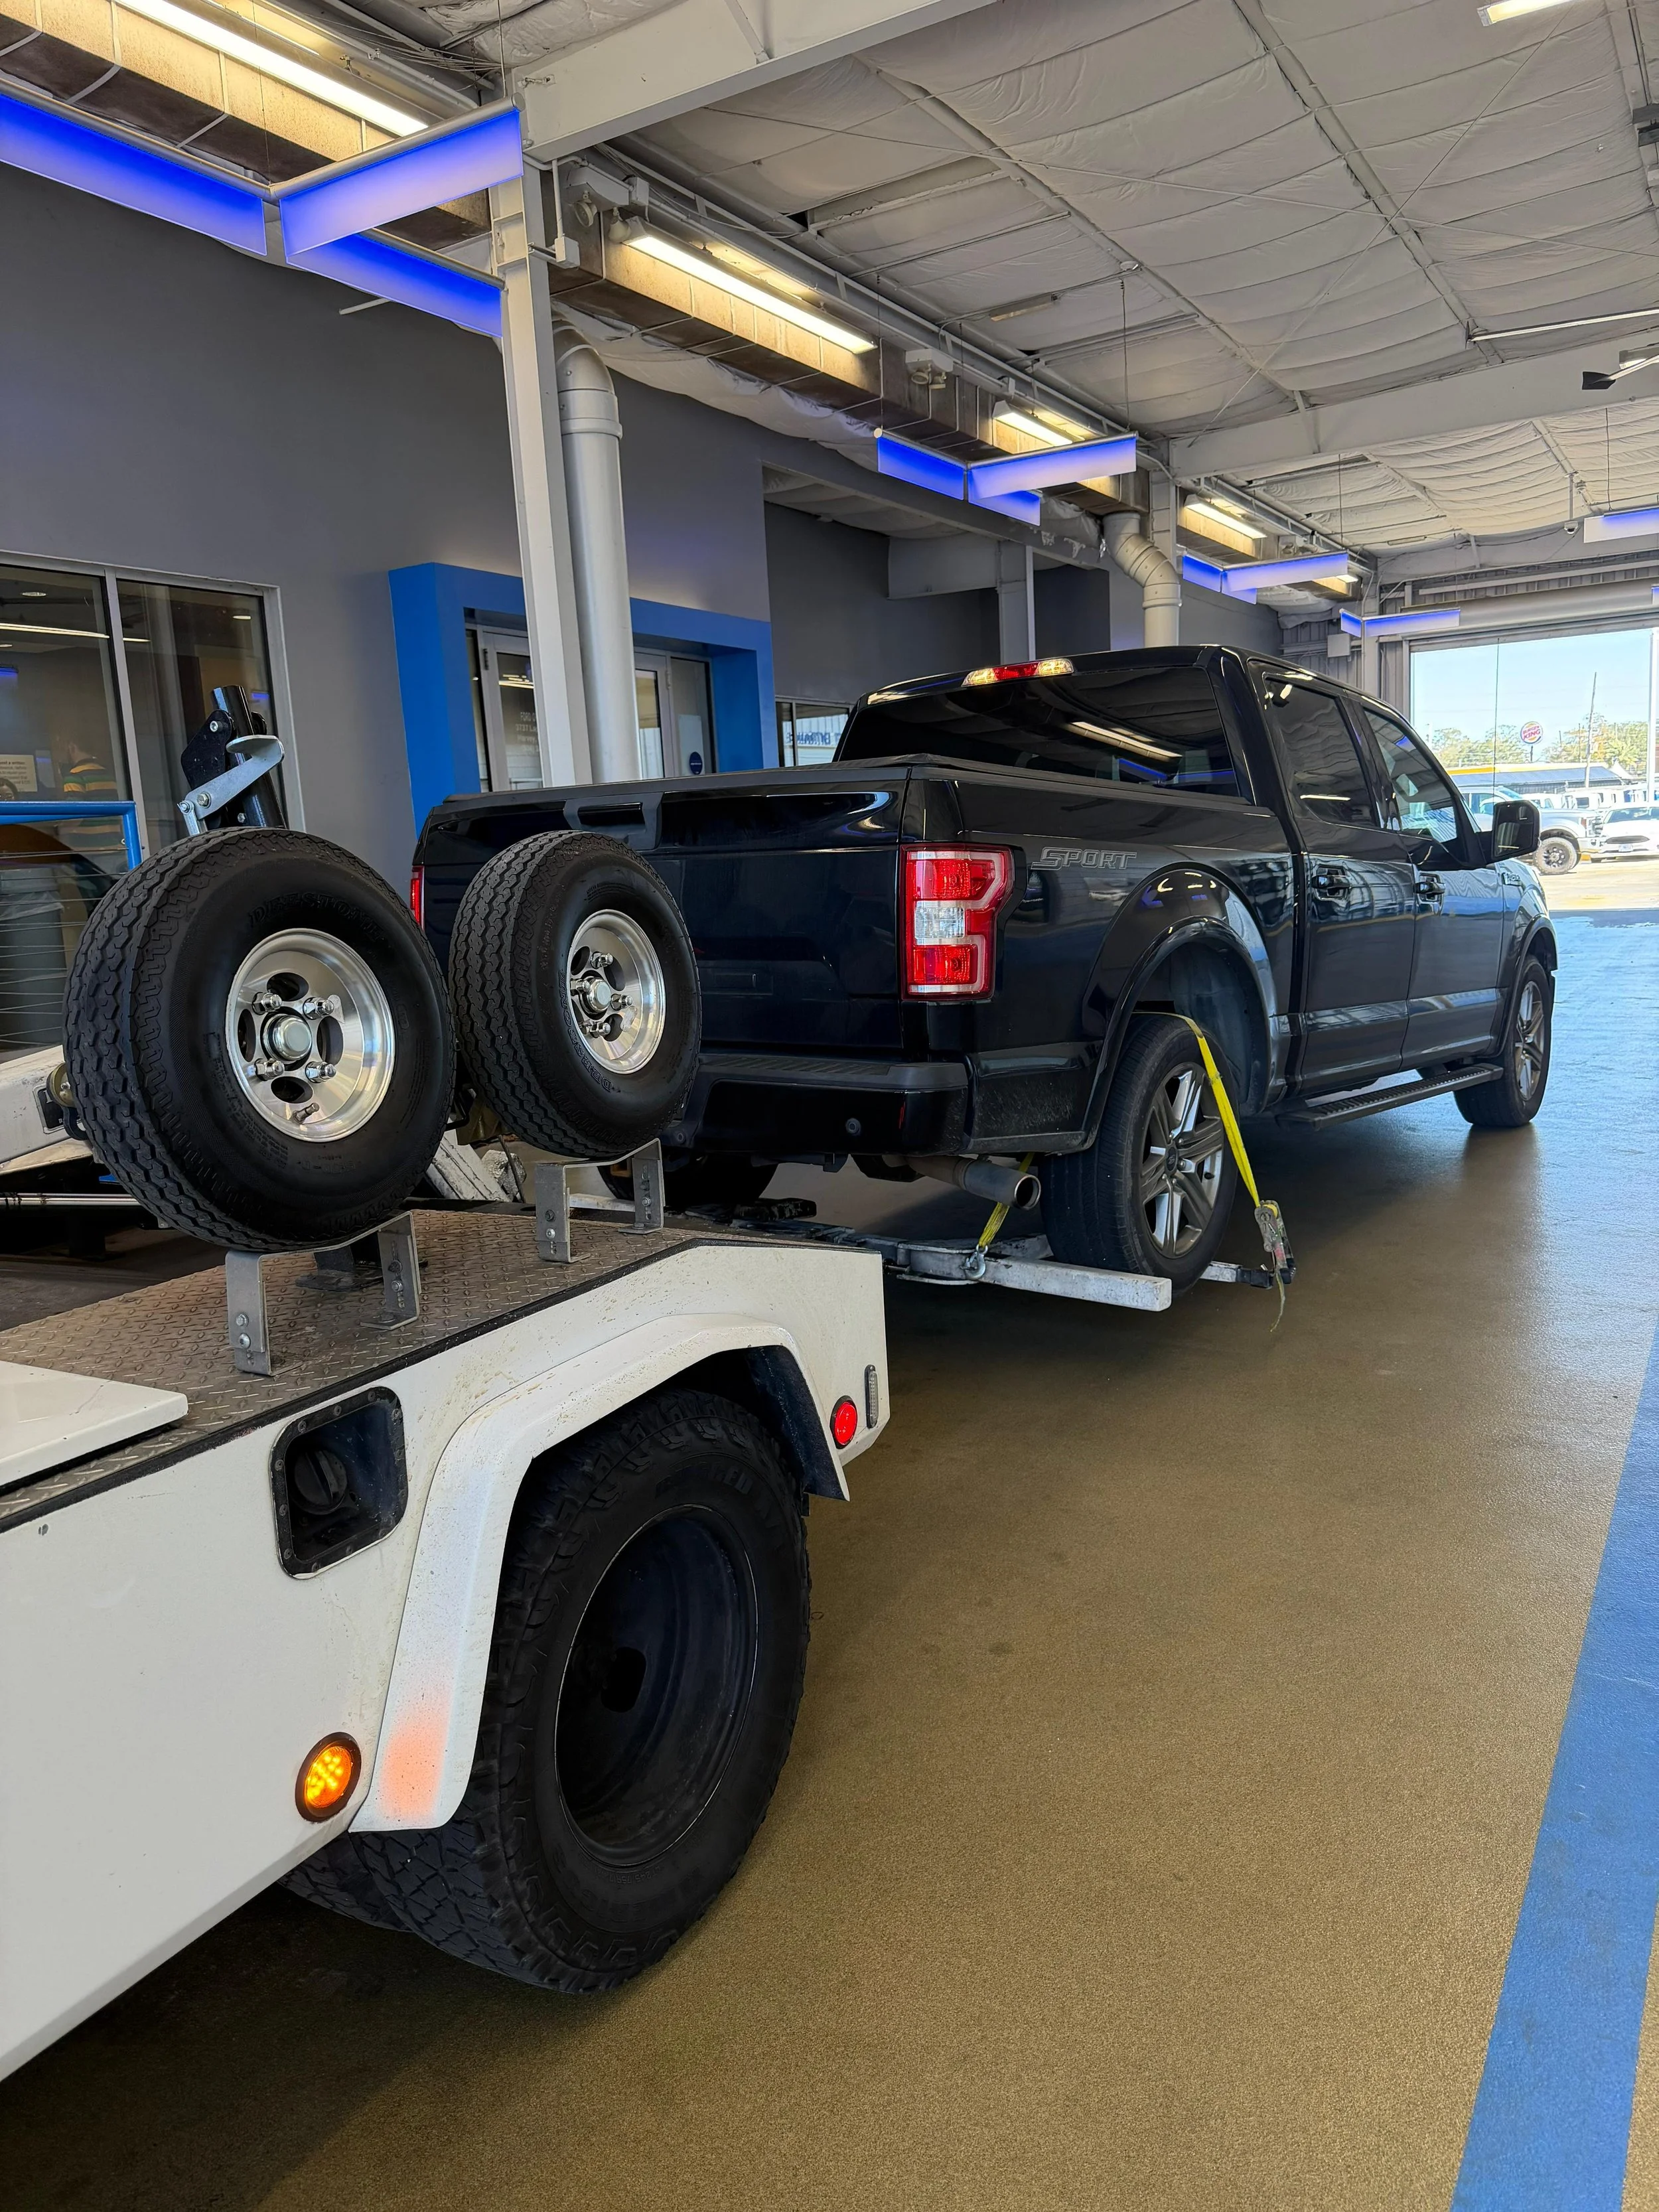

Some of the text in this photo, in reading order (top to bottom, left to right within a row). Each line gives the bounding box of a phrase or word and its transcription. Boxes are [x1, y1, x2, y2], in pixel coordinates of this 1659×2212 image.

[1523, 729, 1541, 740] KING
[1031, 846, 1137, 870] SPORT
[248, 891, 385, 942] DEESTONE
[558, 972, 613, 1092] DEESTONE
